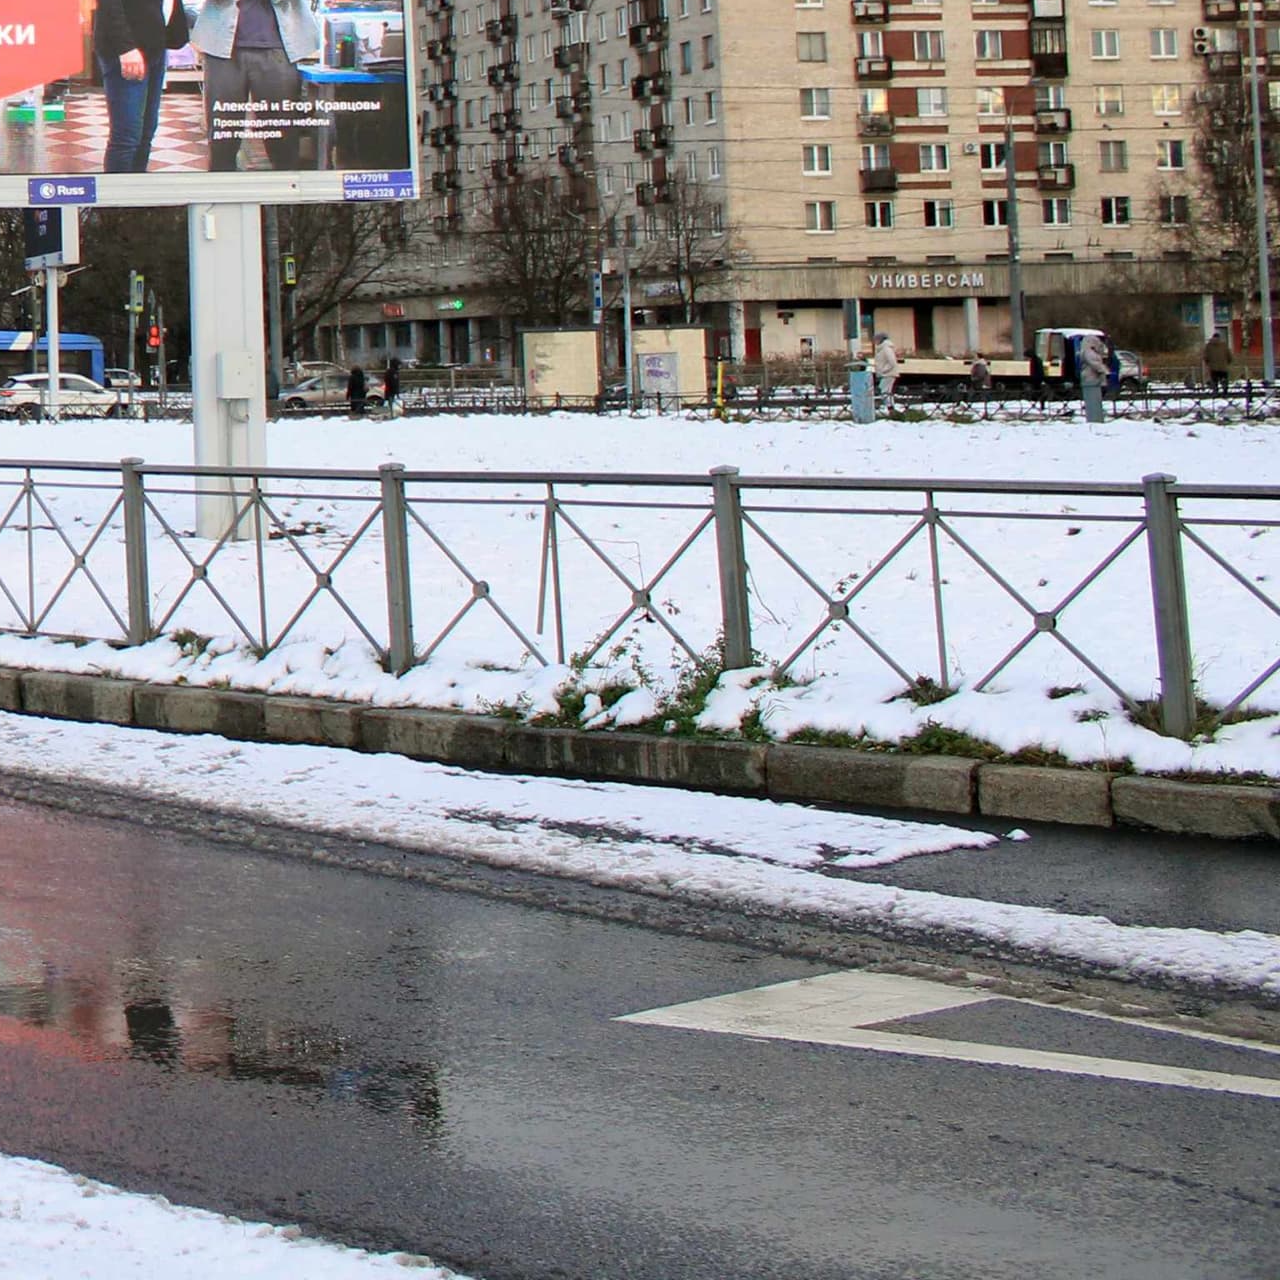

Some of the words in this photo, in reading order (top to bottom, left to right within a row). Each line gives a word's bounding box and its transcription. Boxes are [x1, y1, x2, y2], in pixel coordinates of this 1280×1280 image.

[213, 100, 268, 112] Алексей
[270, 101, 280, 111] и
[282, 99, 312, 114] Егор
[315, 100, 381, 113] Кравцовы
[213, 118, 291, 128] Производители
[292, 117, 330, 126] мебели
[56, 185, 85, 196] Russ
[868, 272, 985, 289] УНИВЕРСАМ
